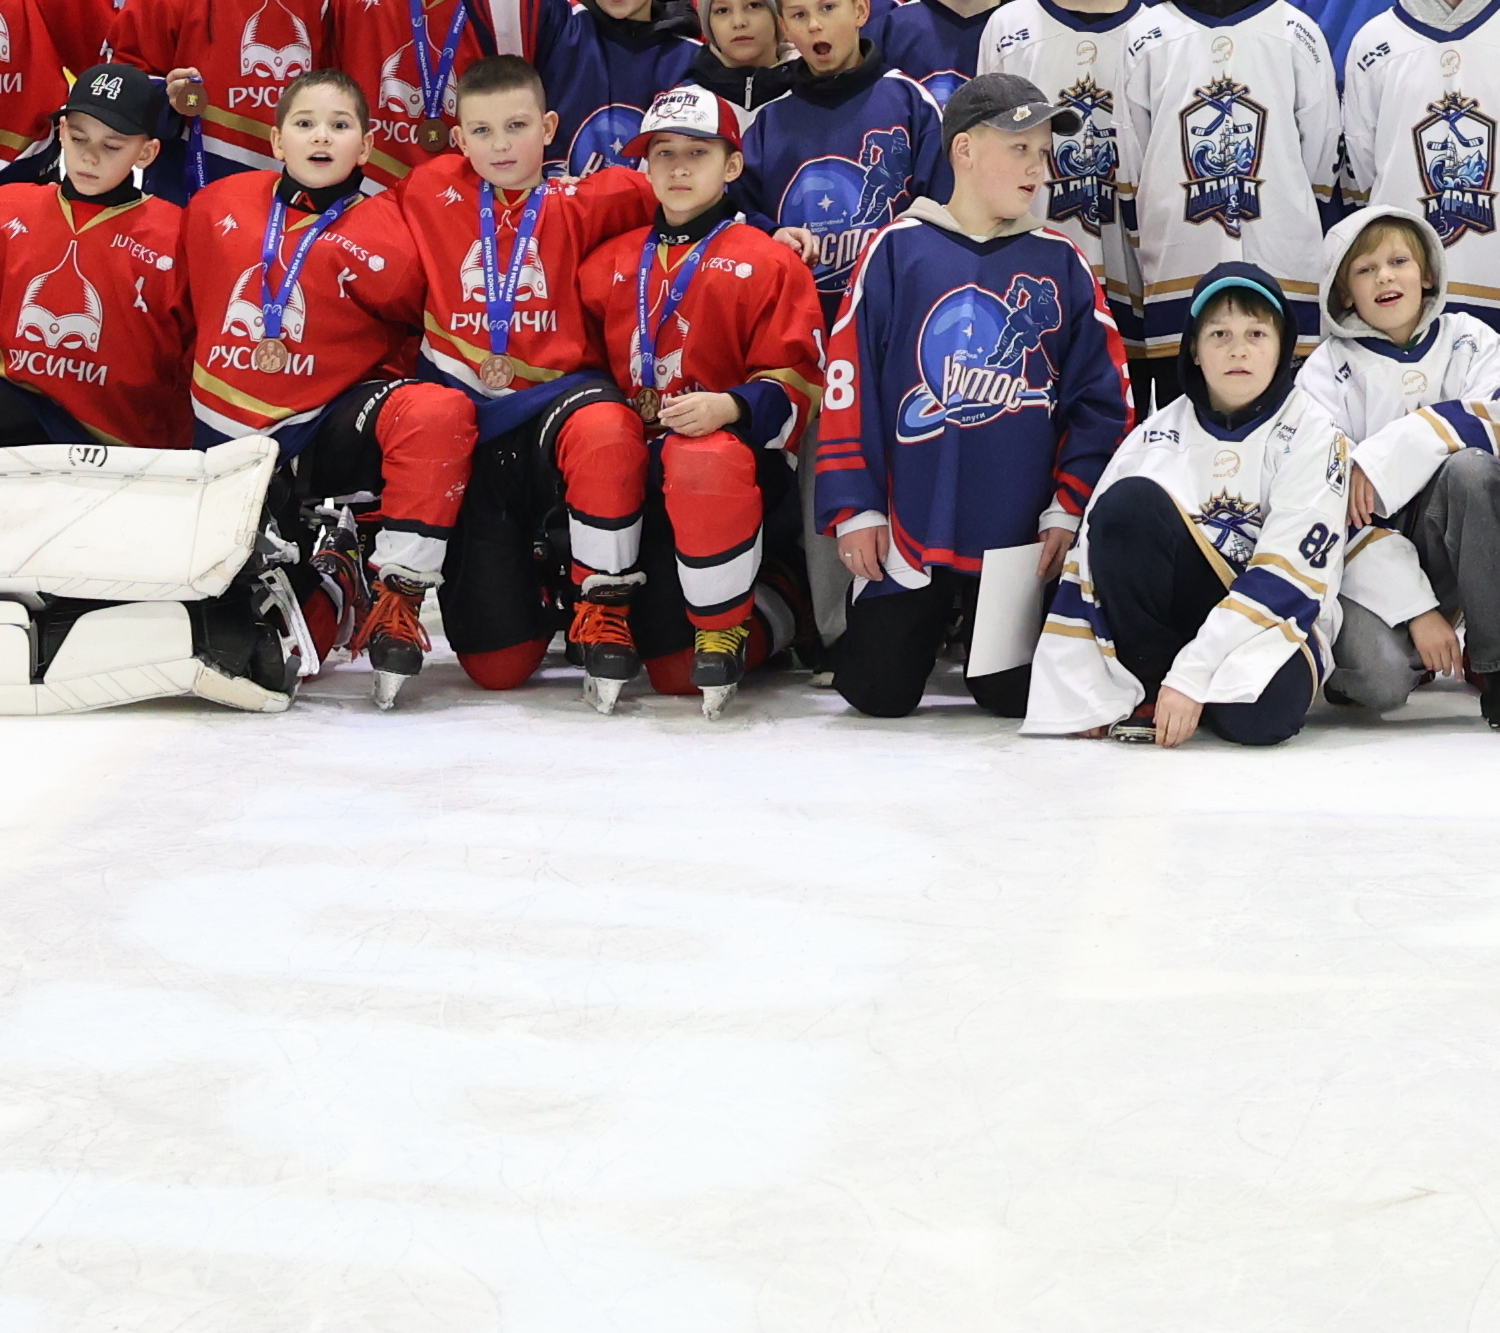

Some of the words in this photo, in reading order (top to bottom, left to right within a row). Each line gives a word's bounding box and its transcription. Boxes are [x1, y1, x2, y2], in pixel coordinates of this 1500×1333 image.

[91, 74, 120, 100] 44
[111, 233, 157, 265] JUTEKS
[450, 310, 557, 333] РУИЧИ
[8, 347, 108, 386] РУСИЧИ
